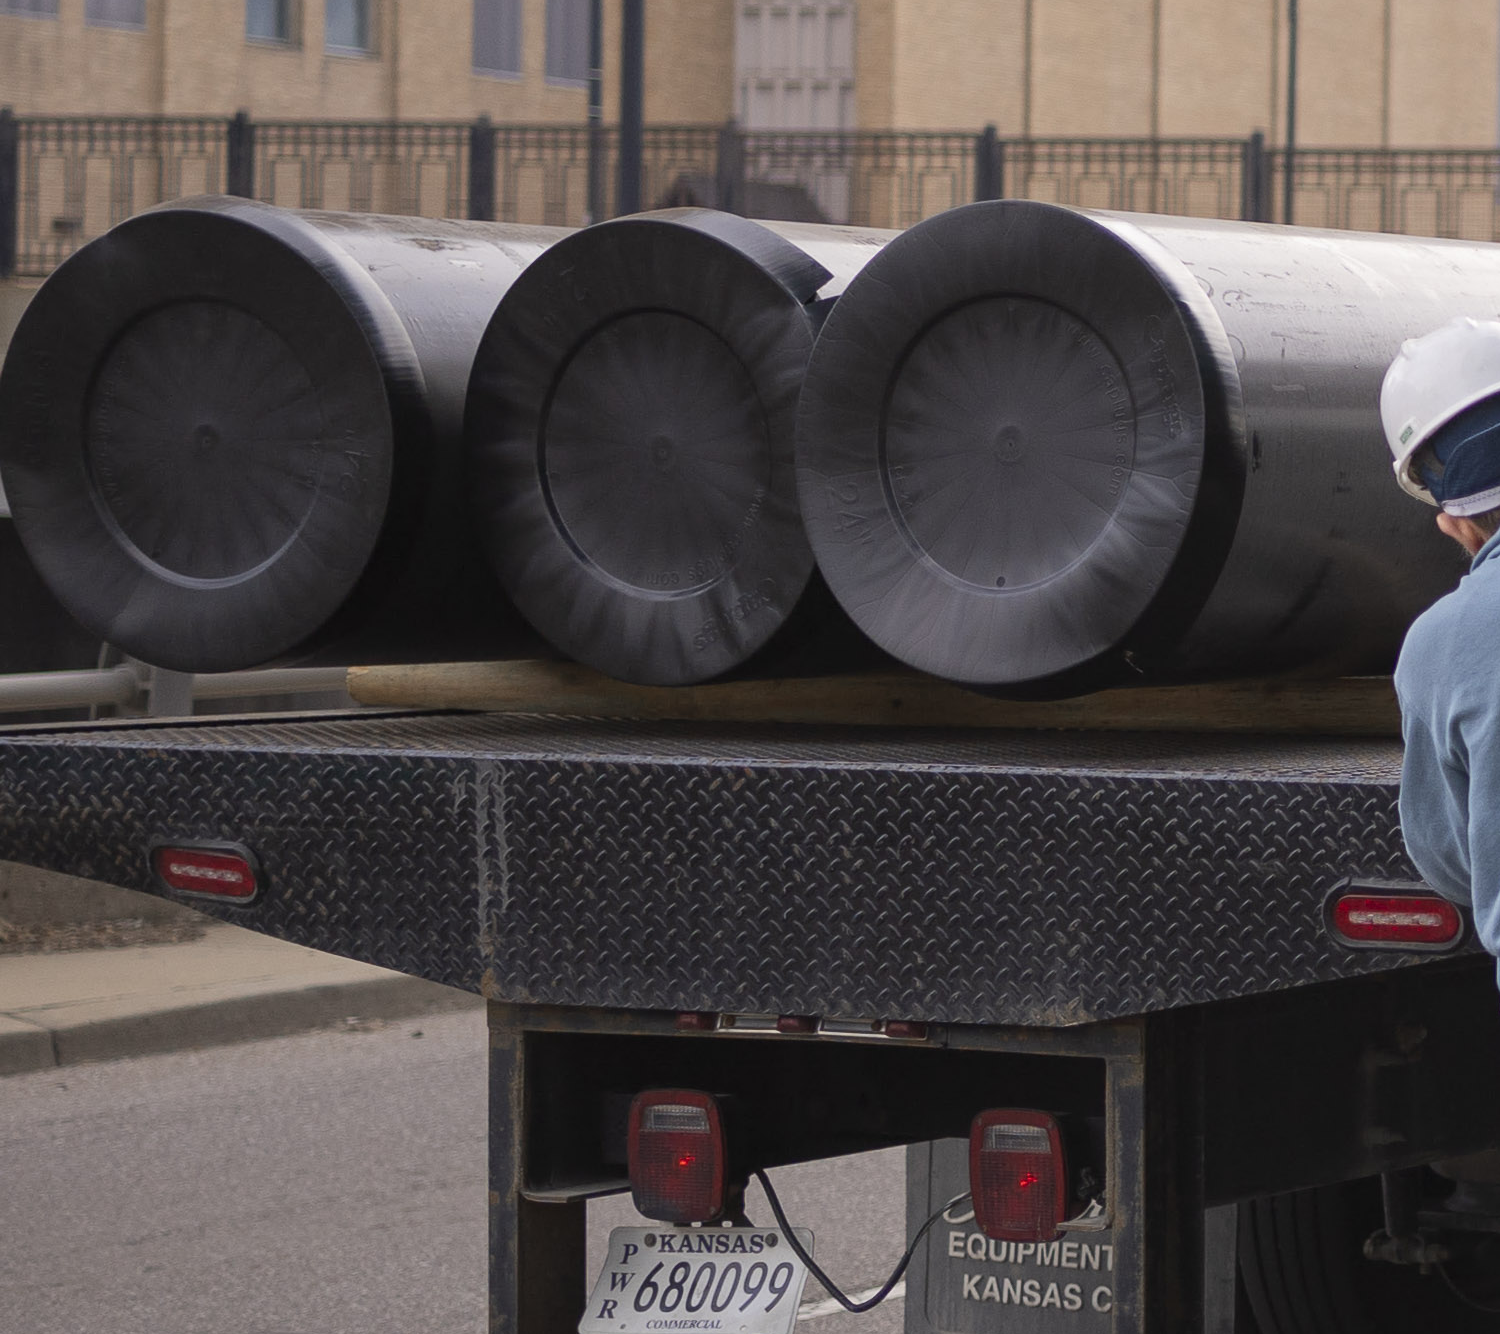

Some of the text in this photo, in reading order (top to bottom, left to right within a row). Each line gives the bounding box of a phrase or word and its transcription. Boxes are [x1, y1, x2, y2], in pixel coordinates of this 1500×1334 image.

[658, 1234, 765, 1254] KANSAS
[633, 1261, 795, 1313] 680099
[962, 1273, 1083, 1312] KANSAS
[646, 1319, 723, 1330] COMMERCIAL
